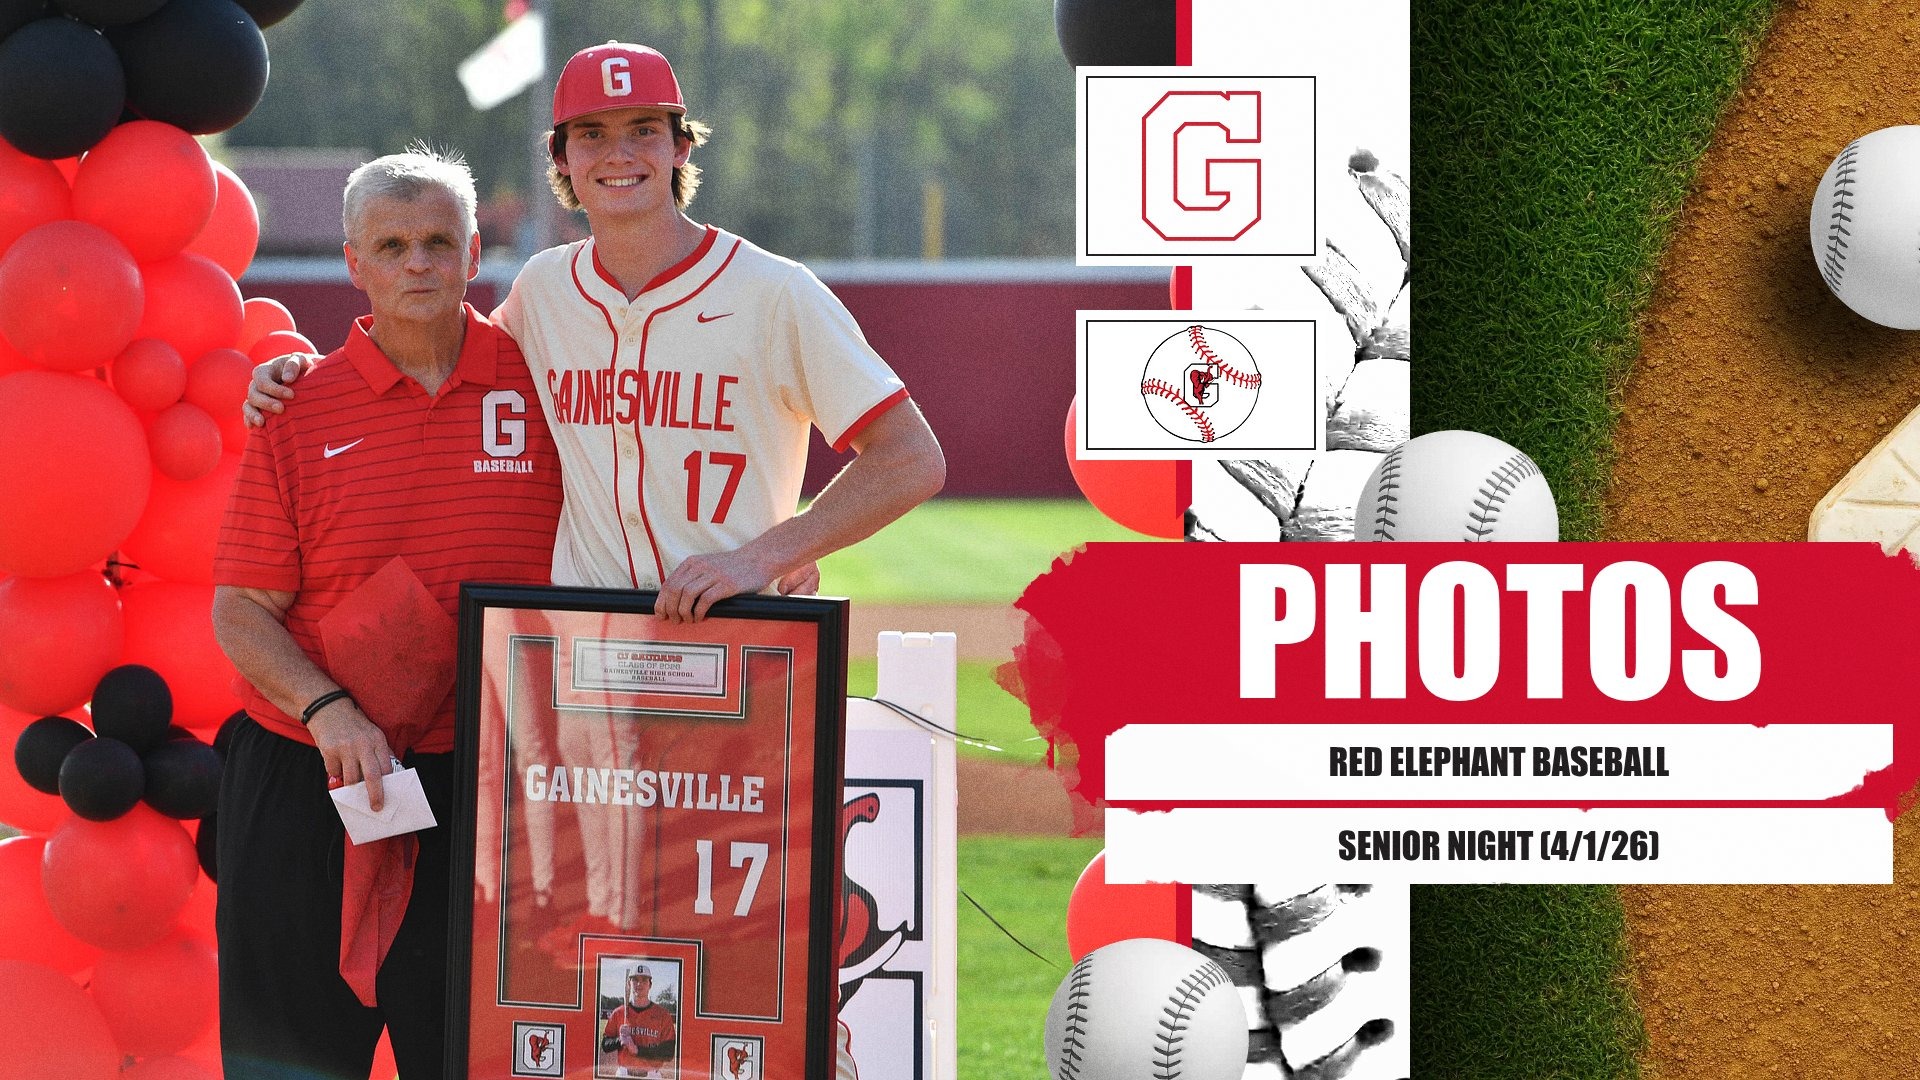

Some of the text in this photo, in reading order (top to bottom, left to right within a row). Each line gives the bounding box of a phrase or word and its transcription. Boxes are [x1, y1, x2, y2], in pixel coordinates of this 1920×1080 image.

[601, 57, 632, 97] G
[482, 389, 526, 458] G
[547, 368, 739, 432] GAINESVILLE
[473, 459, 534, 473] BASEBALL
[684, 450, 747, 524] 17
[604, 668, 648, 676] GAINESVILLE
[526, 764, 764, 813] GAINESVILLE
[695, 839, 769, 917] 17
